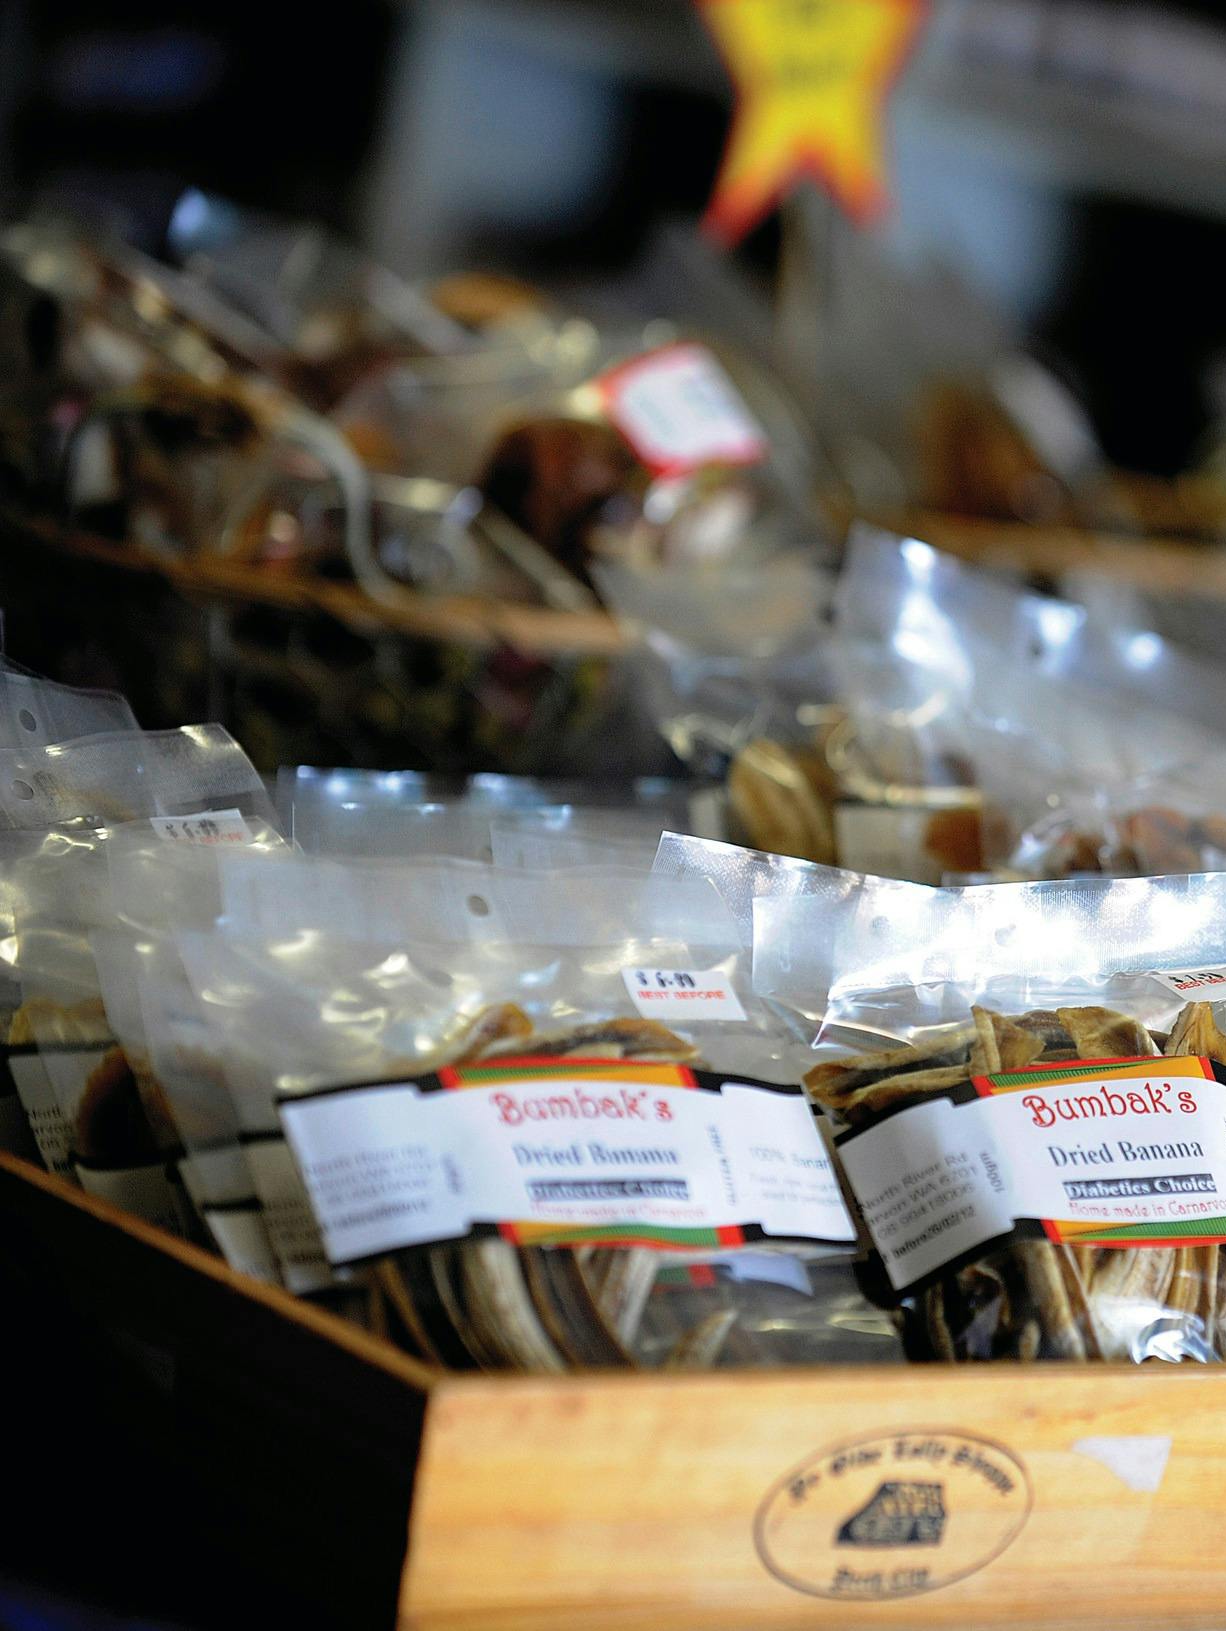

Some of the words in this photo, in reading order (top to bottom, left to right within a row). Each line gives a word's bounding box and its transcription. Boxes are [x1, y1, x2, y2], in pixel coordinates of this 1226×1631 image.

[1174, 980, 1206, 991] BEST
[490, 1086, 675, 1126] Bumbak's
[1022, 1082, 1199, 1128] Bumbak's
[1047, 1141, 1114, 1168] Dried
[1117, 1139, 1205, 1162] Banana
[902, 1161, 941, 1189] River
[1065, 1180, 1150, 1200] Diabetics
[1154, 1175, 1217, 1195] Choice
[1112, 1203, 1149, 1218] made
[1152, 1202, 1166, 1217] in
